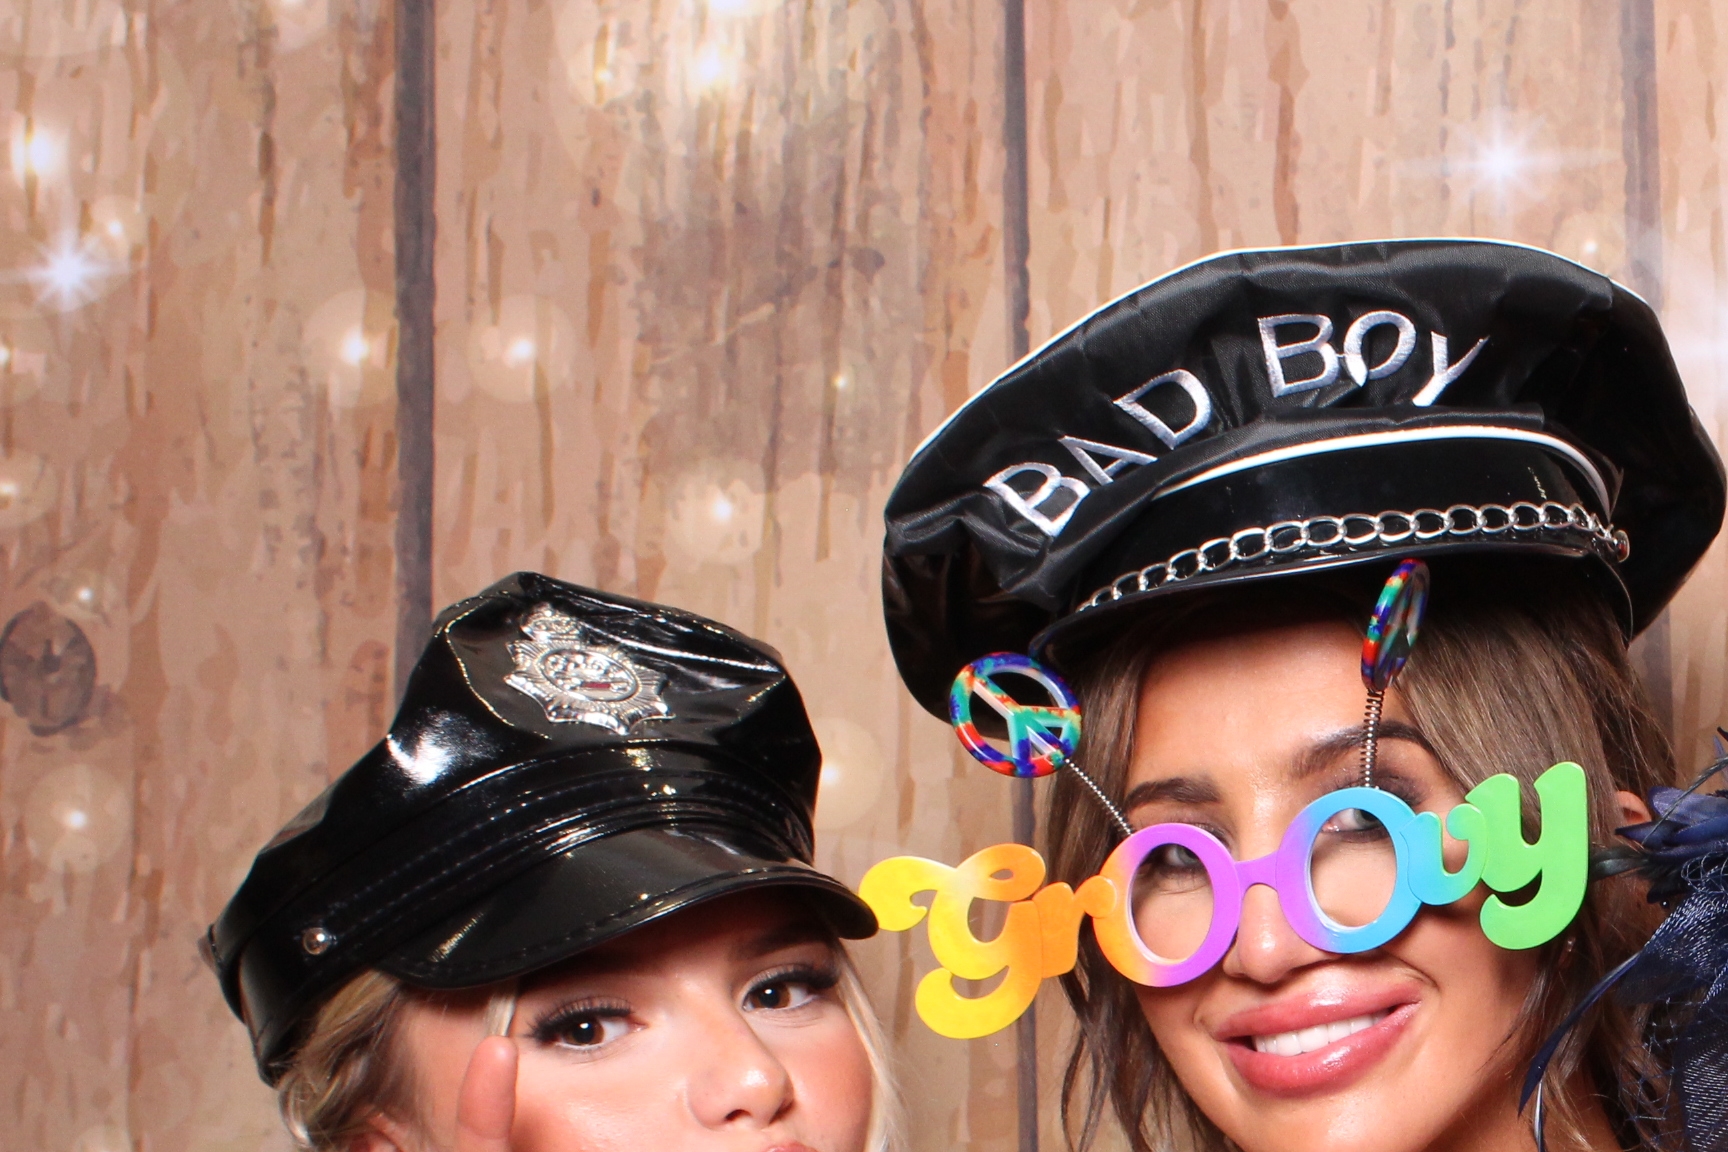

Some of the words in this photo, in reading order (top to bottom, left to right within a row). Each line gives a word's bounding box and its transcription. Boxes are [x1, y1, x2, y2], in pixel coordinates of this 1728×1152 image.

[983, 368, 1212, 537] BAD
[1257, 310, 1490, 406] BOY
[859, 762, 1588, 1039] groovy
